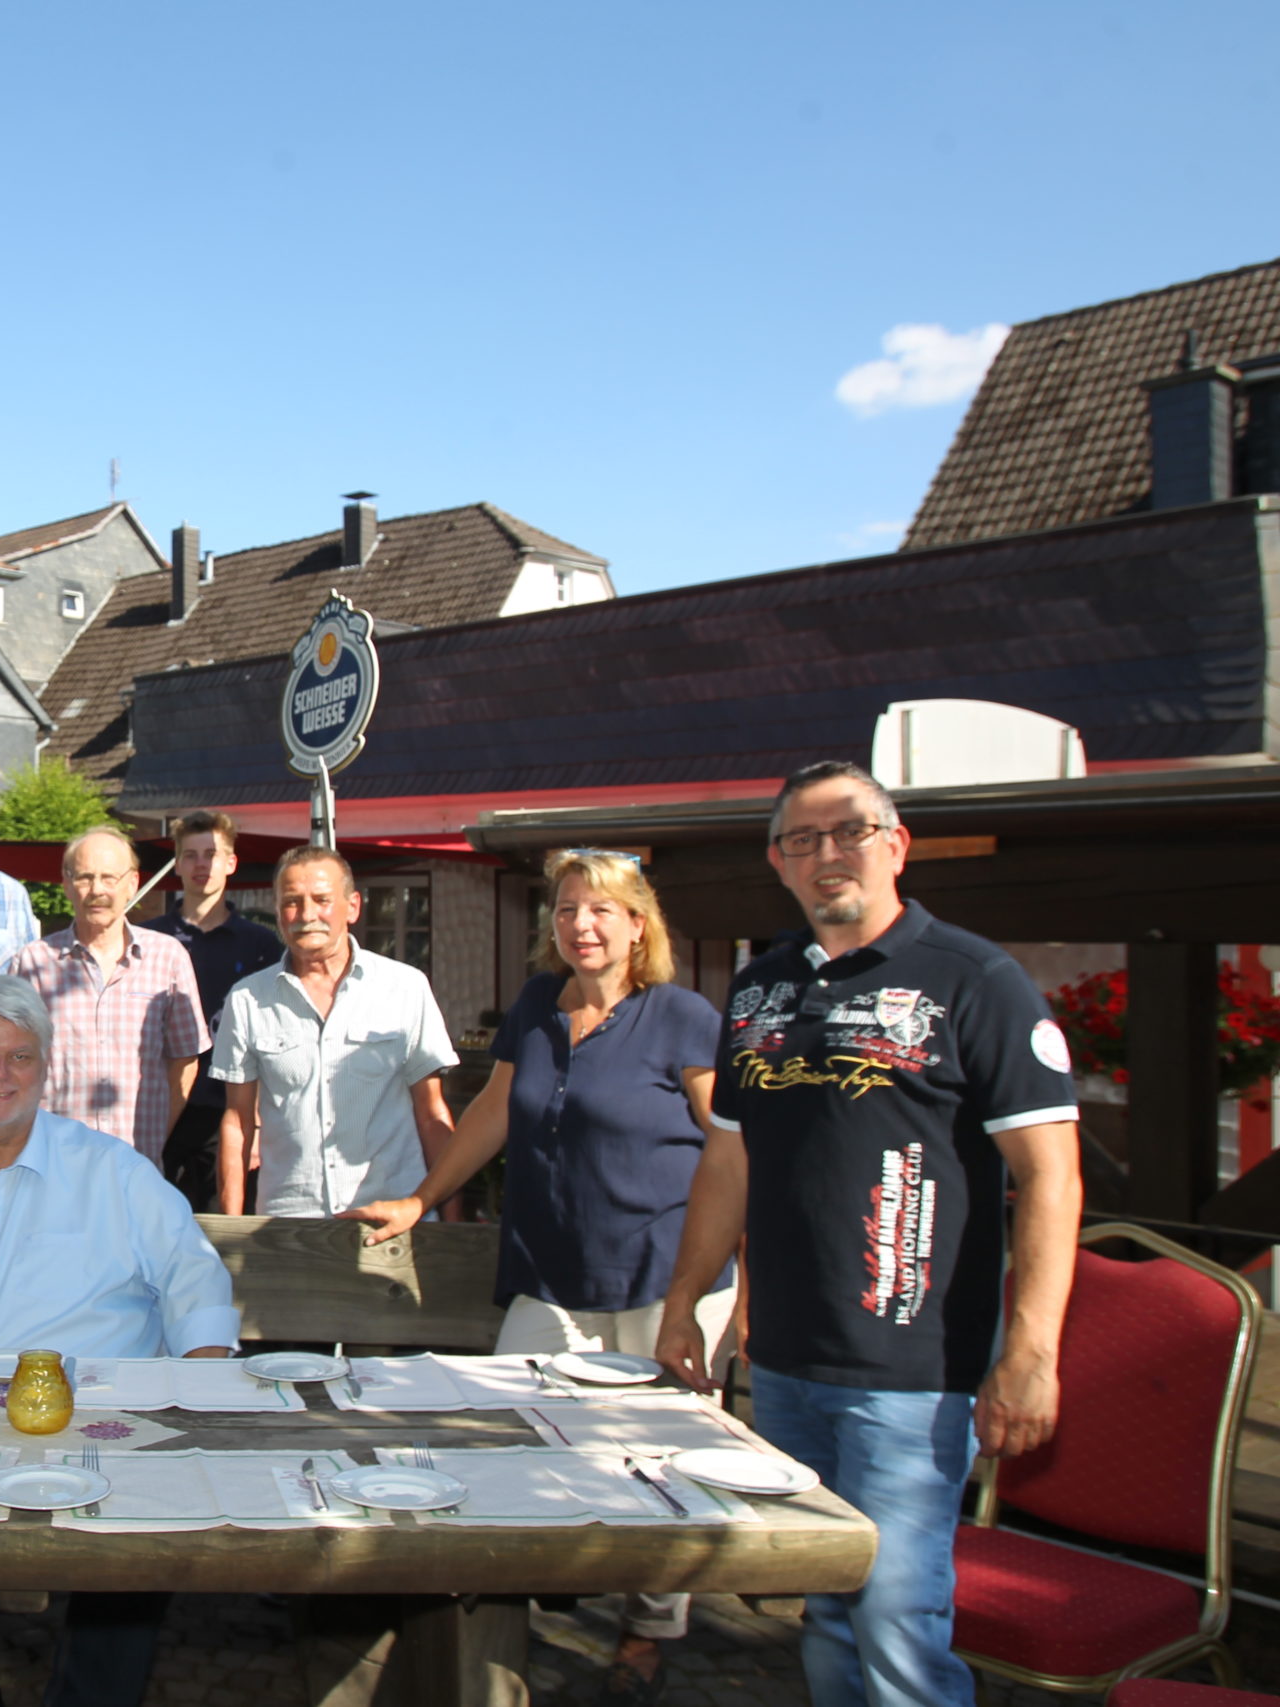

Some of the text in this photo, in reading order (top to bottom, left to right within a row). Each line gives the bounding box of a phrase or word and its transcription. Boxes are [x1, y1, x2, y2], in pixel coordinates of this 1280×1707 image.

[294, 672, 358, 715] SCHNEIDER
[301, 700, 346, 736] WEISSE
[905, 1142, 924, 1186] CLUB
[900, 1188, 921, 1265] HOPPING
